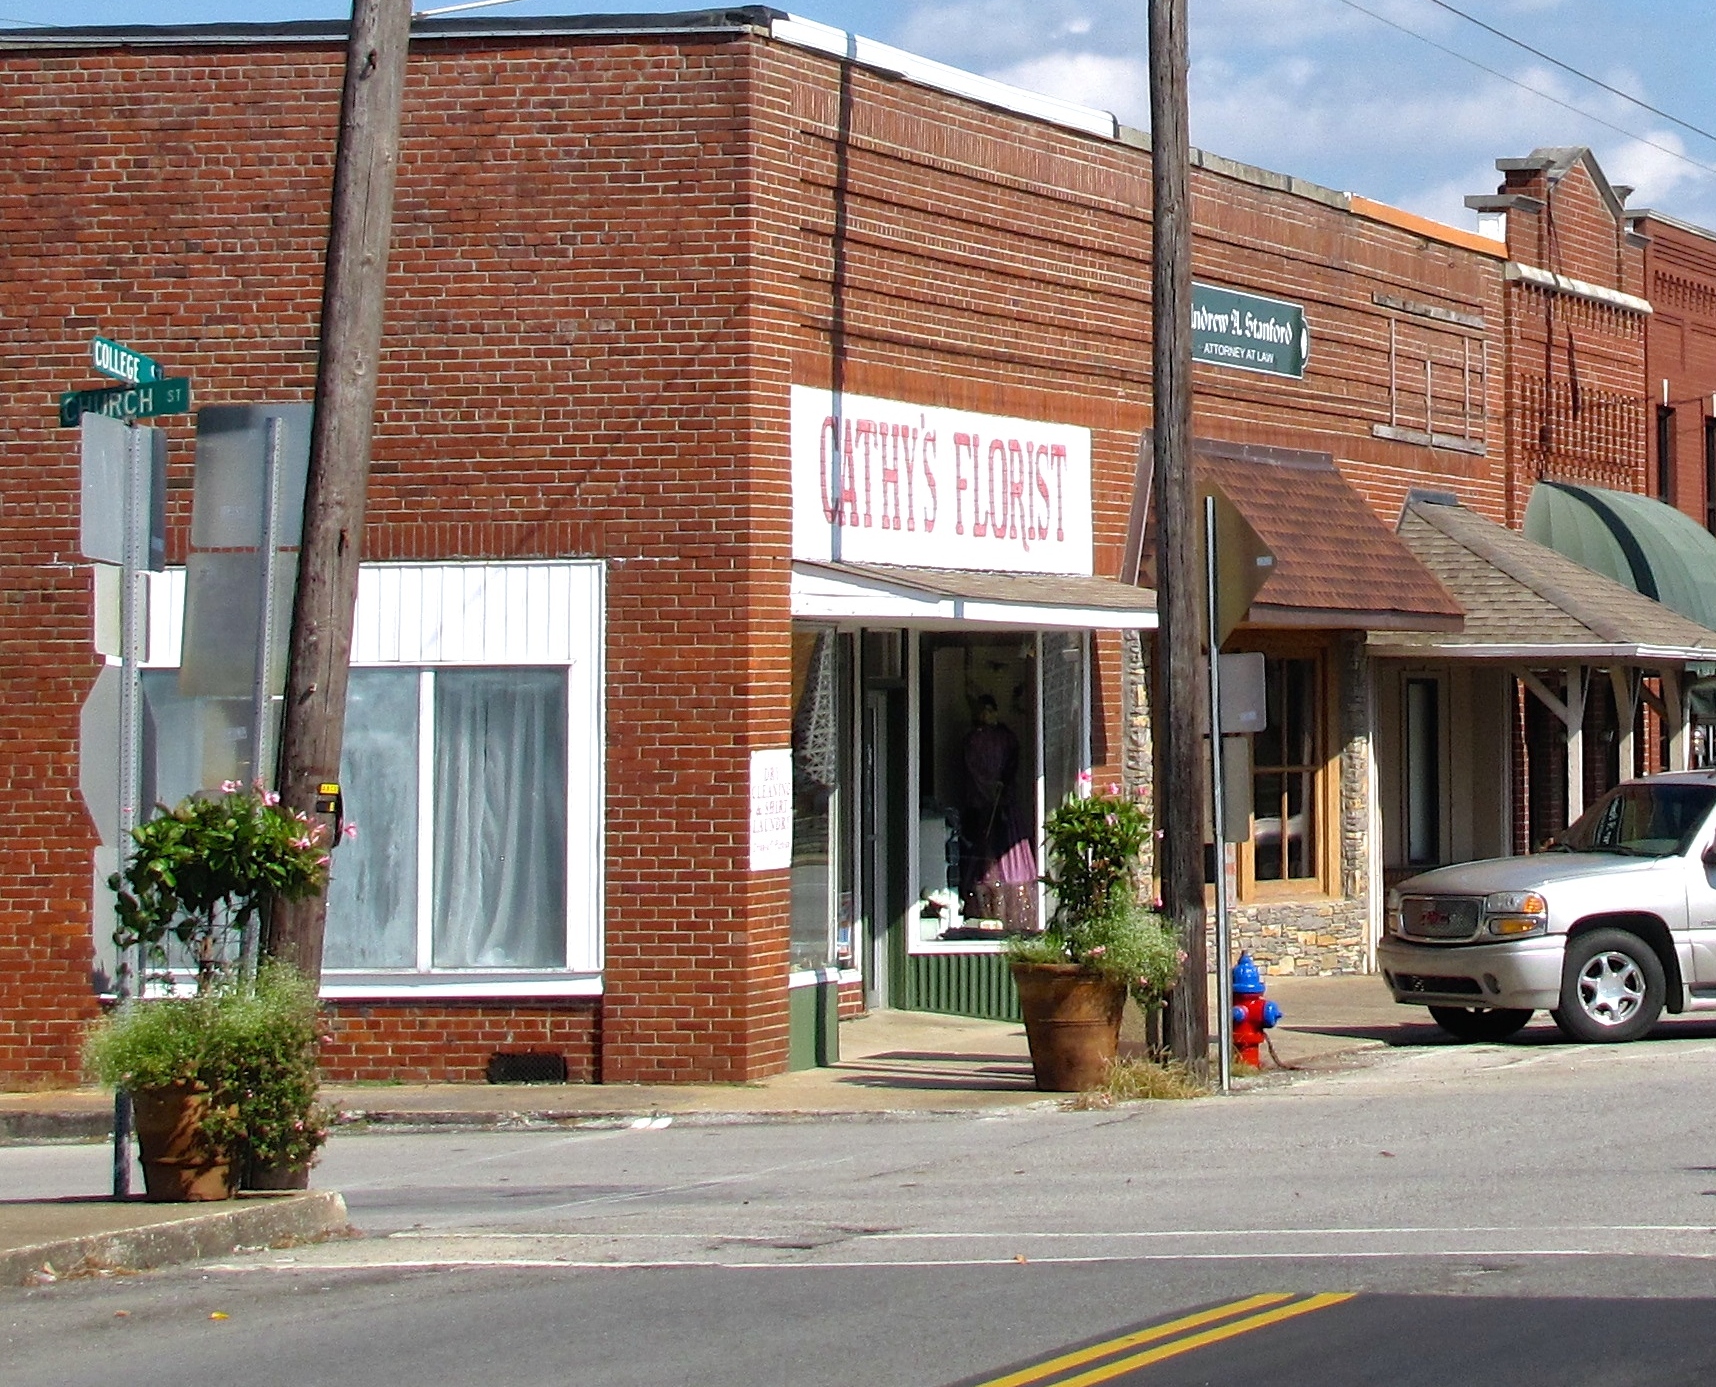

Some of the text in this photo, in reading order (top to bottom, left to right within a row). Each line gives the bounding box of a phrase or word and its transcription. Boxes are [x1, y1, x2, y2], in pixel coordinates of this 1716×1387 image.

[1245, 311, 1293, 345] Stanford
[95, 340, 141, 384] COLLEGE
[1203, 342, 1274, 364] ATTORNEY AT LAW
[63, 388, 181, 422] CHURCH ST
[820, 413, 1068, 552] CATHY'S FLORIST
